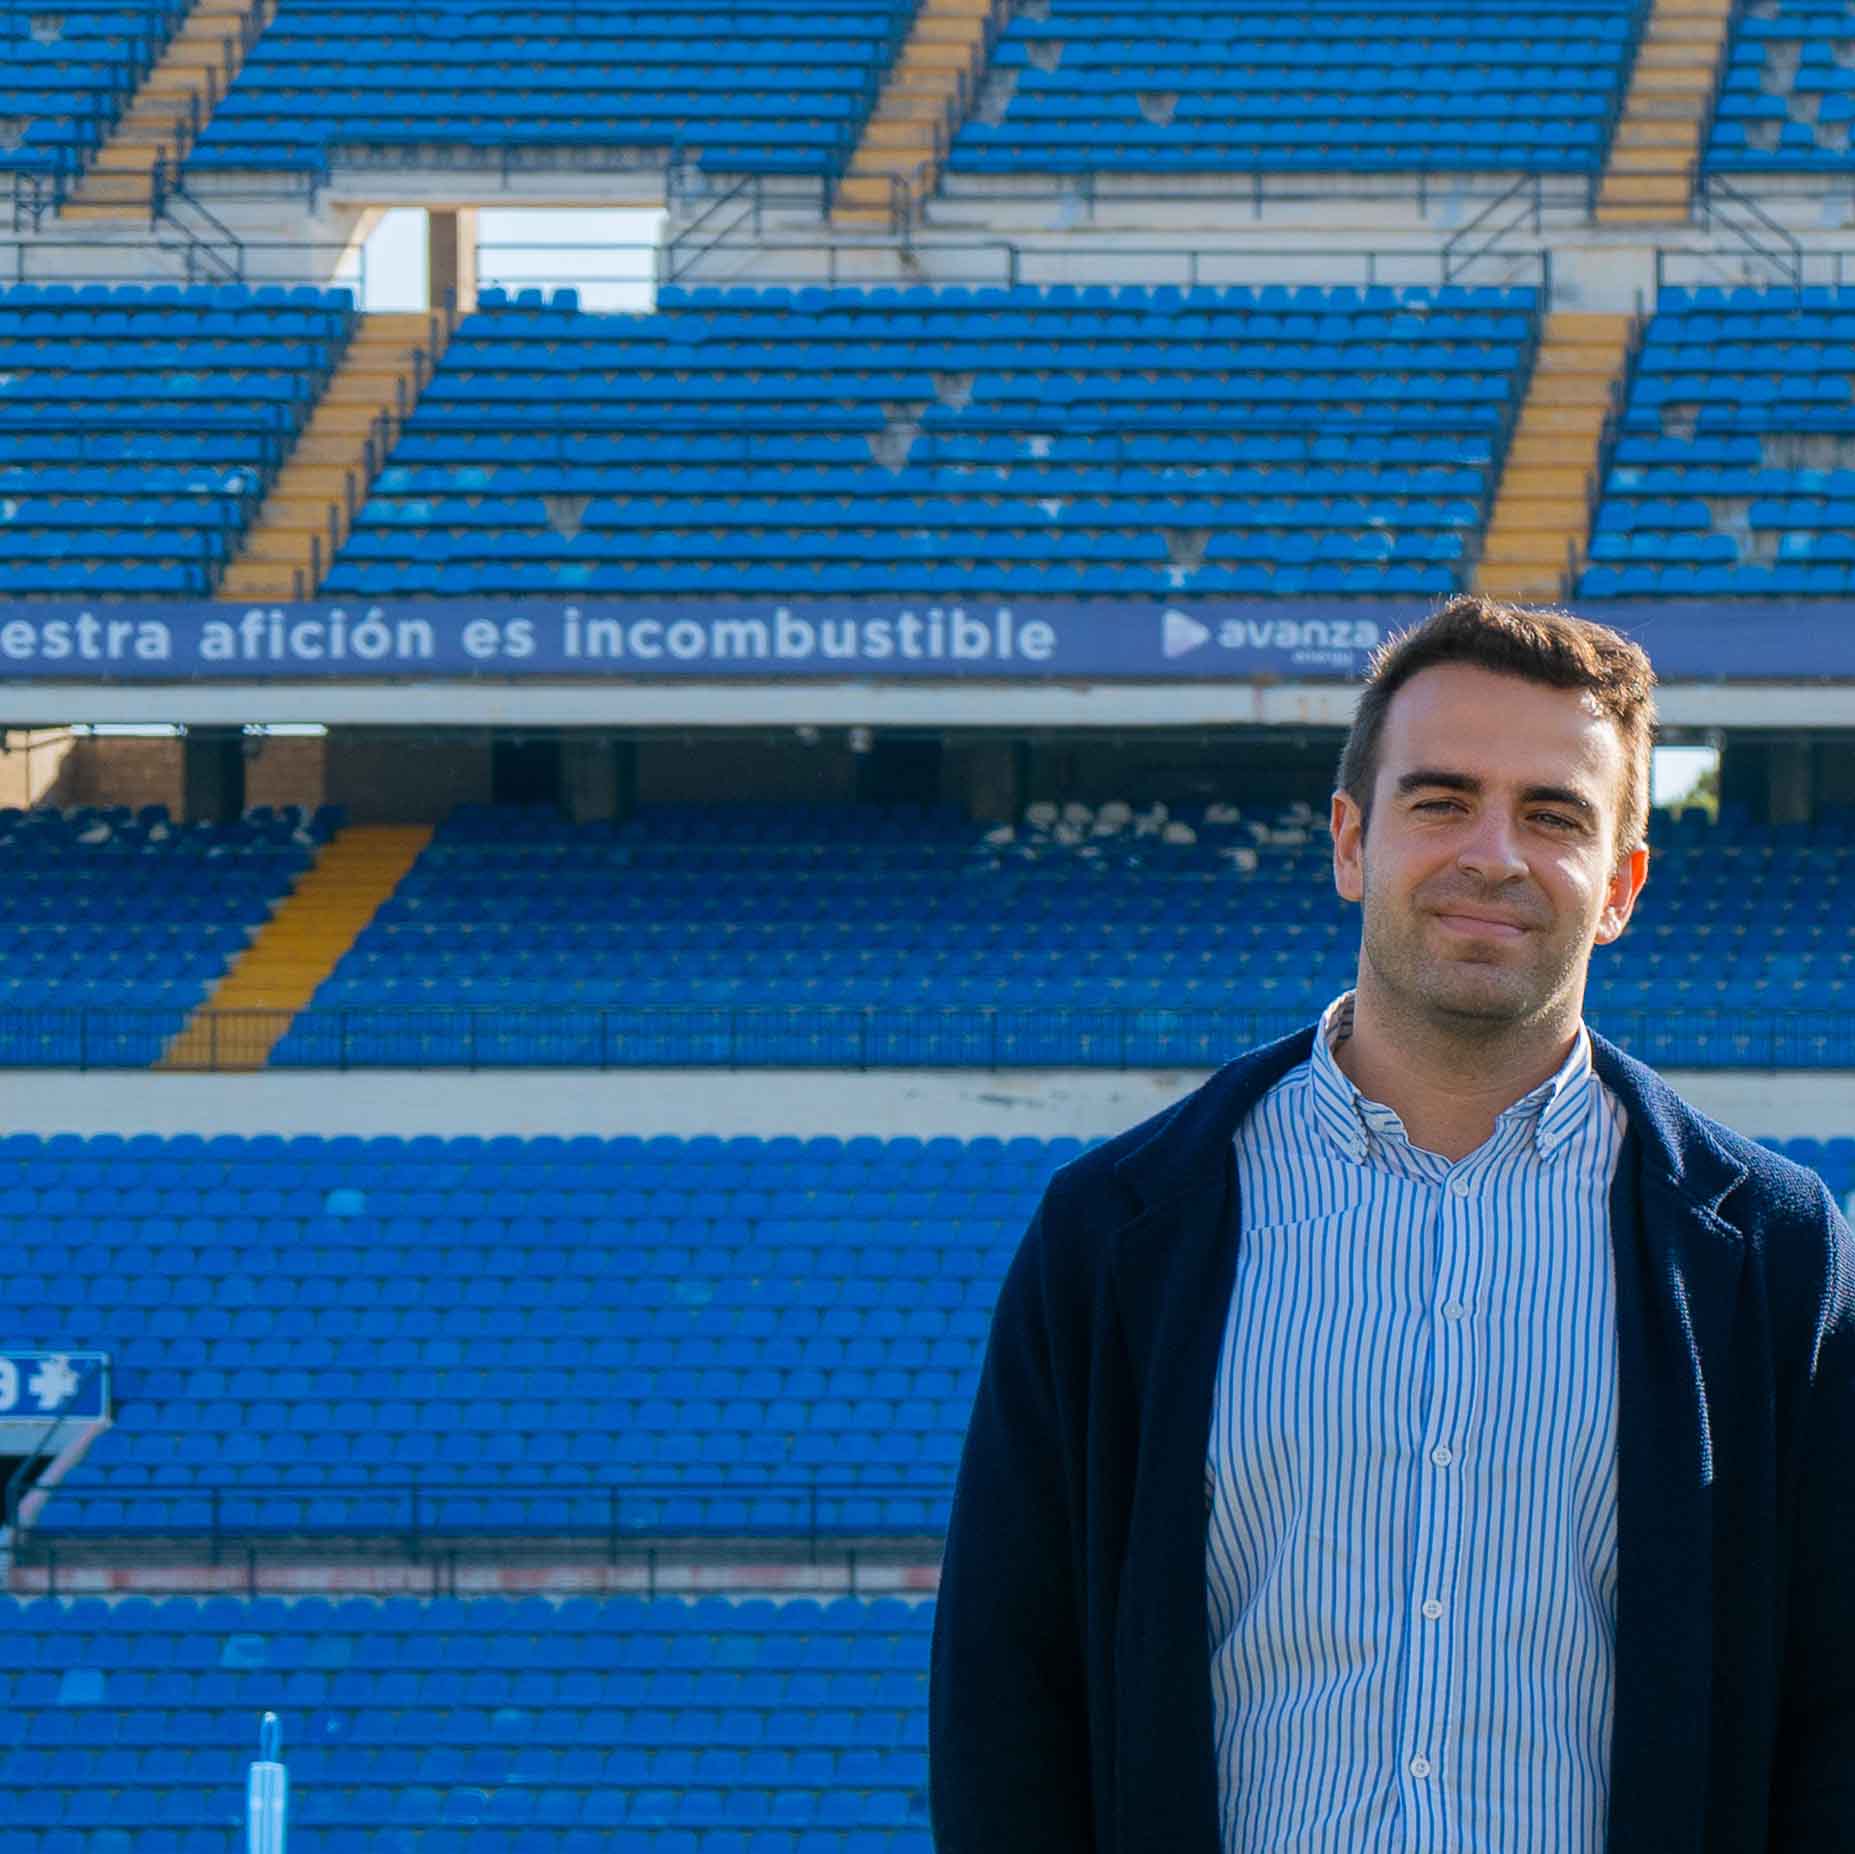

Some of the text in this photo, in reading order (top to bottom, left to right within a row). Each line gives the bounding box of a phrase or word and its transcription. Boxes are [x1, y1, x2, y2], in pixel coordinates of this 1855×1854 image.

[199, 607, 433, 660] afición
[462, 616, 536, 660] es
[564, 607, 1057, 660] incombustible
[1217, 619, 1380, 649] avanza
